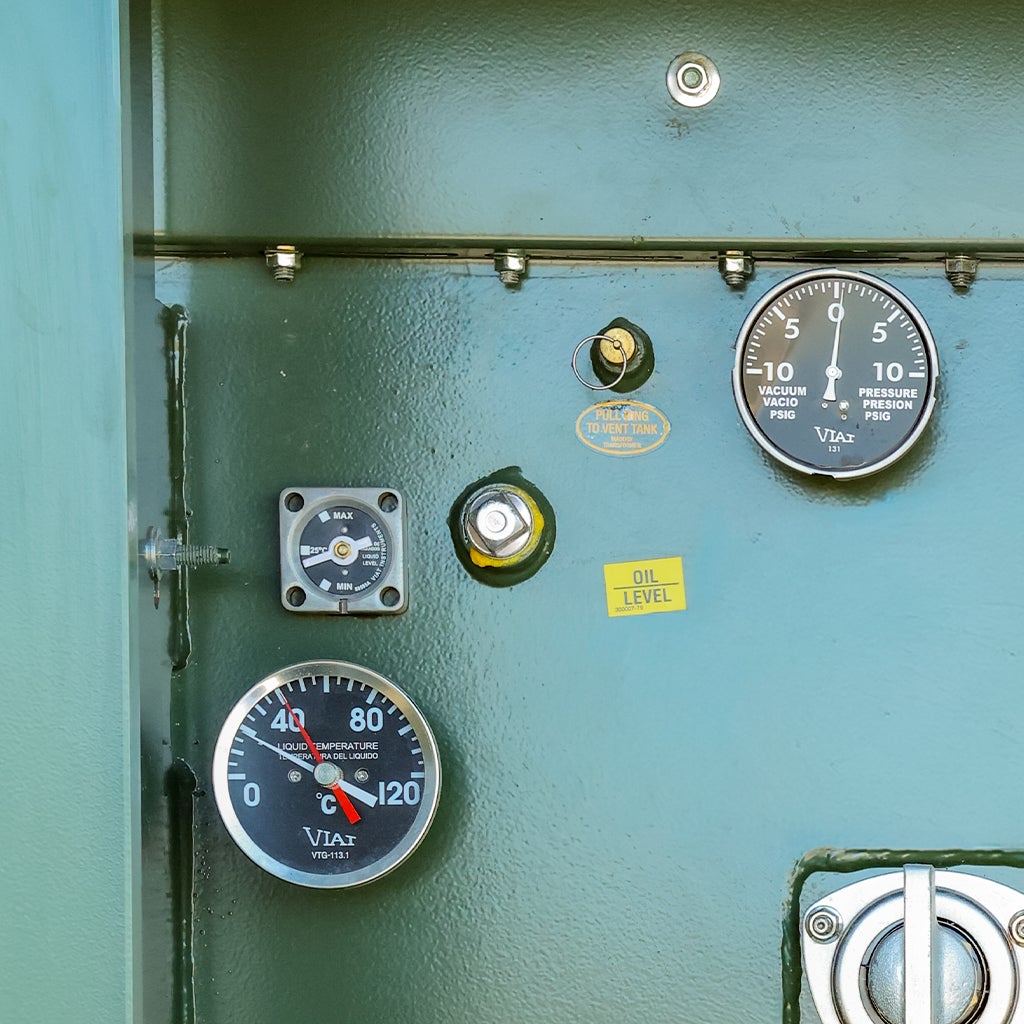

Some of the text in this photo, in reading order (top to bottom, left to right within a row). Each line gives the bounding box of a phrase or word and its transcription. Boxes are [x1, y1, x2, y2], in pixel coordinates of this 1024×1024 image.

[827, 303, 844, 322] 0
[784, 318, 800, 339] 5
[872, 322, 887, 342] 5
[763, 362, 794, 381] 10
[872, 362, 903, 381] 10
[758, 386, 807, 396] VACUUM
[859, 388, 918, 398] PRESSURE
[763, 398, 798, 407] VACIO
[863, 400, 912, 410] PRESION
[596, 409, 620, 421] PULL
[770, 410, 796, 419] PSIG
[865, 411, 891, 421] PSIG
[587, 422, 657, 434] TO VENT TANK
[828, 445, 840, 453] 131
[333, 512, 353, 520] MAX
[633, 569, 658, 584] OIL
[624, 588, 672, 605] LEVEL
[270, 707, 383, 732] 40 80
[349, 752, 378, 760] LIQUIDO
[243, 782, 260, 807] 0
[378, 781, 420, 806] 120
[315, 792, 337, 815] °C
[311, 851, 349, 859] VTG-113.1
